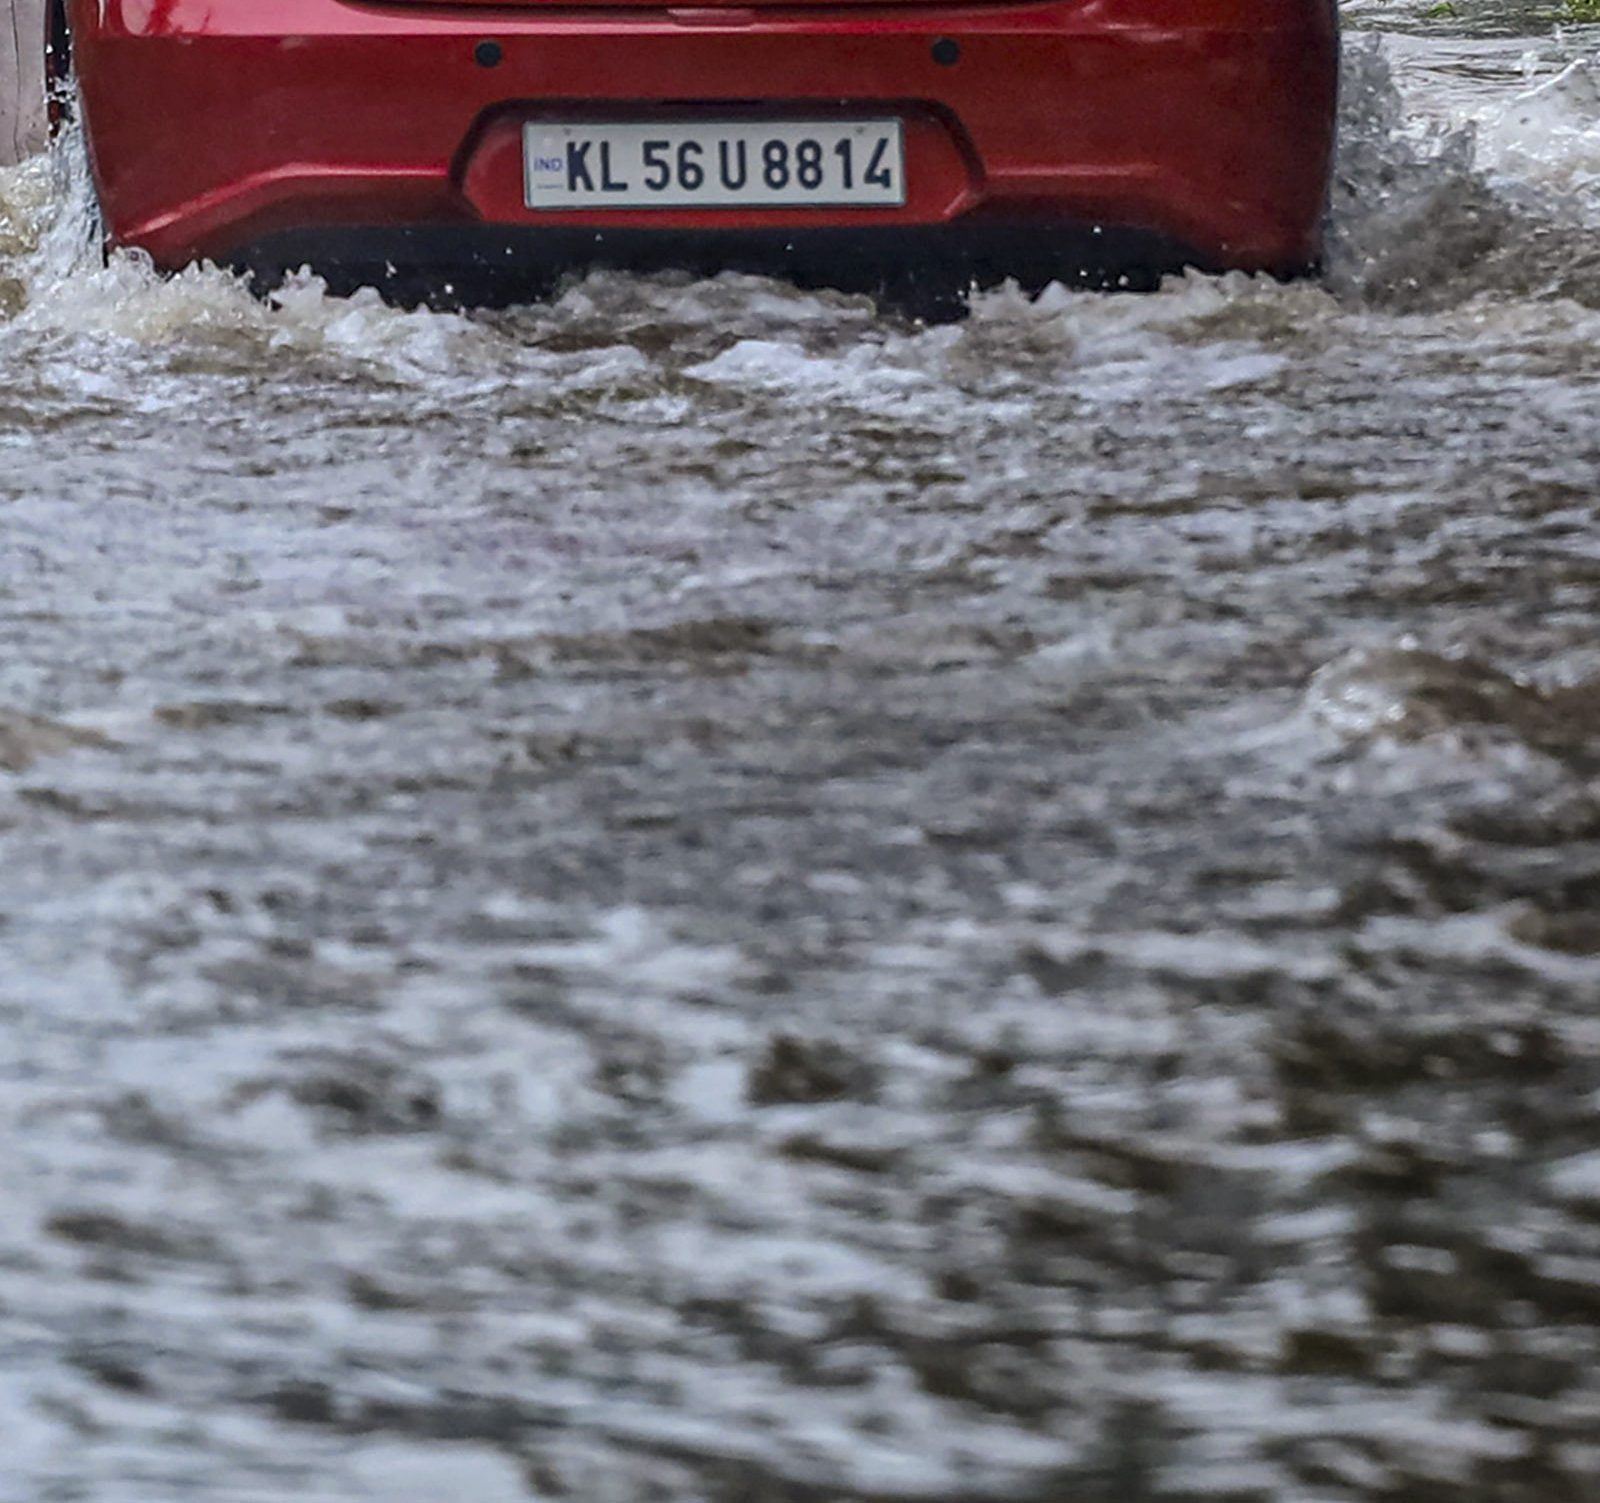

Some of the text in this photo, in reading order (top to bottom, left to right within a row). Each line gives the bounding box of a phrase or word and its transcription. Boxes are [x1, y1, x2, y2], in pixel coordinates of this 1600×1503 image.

[533, 137, 892, 192] IND KL 56 U 8814
